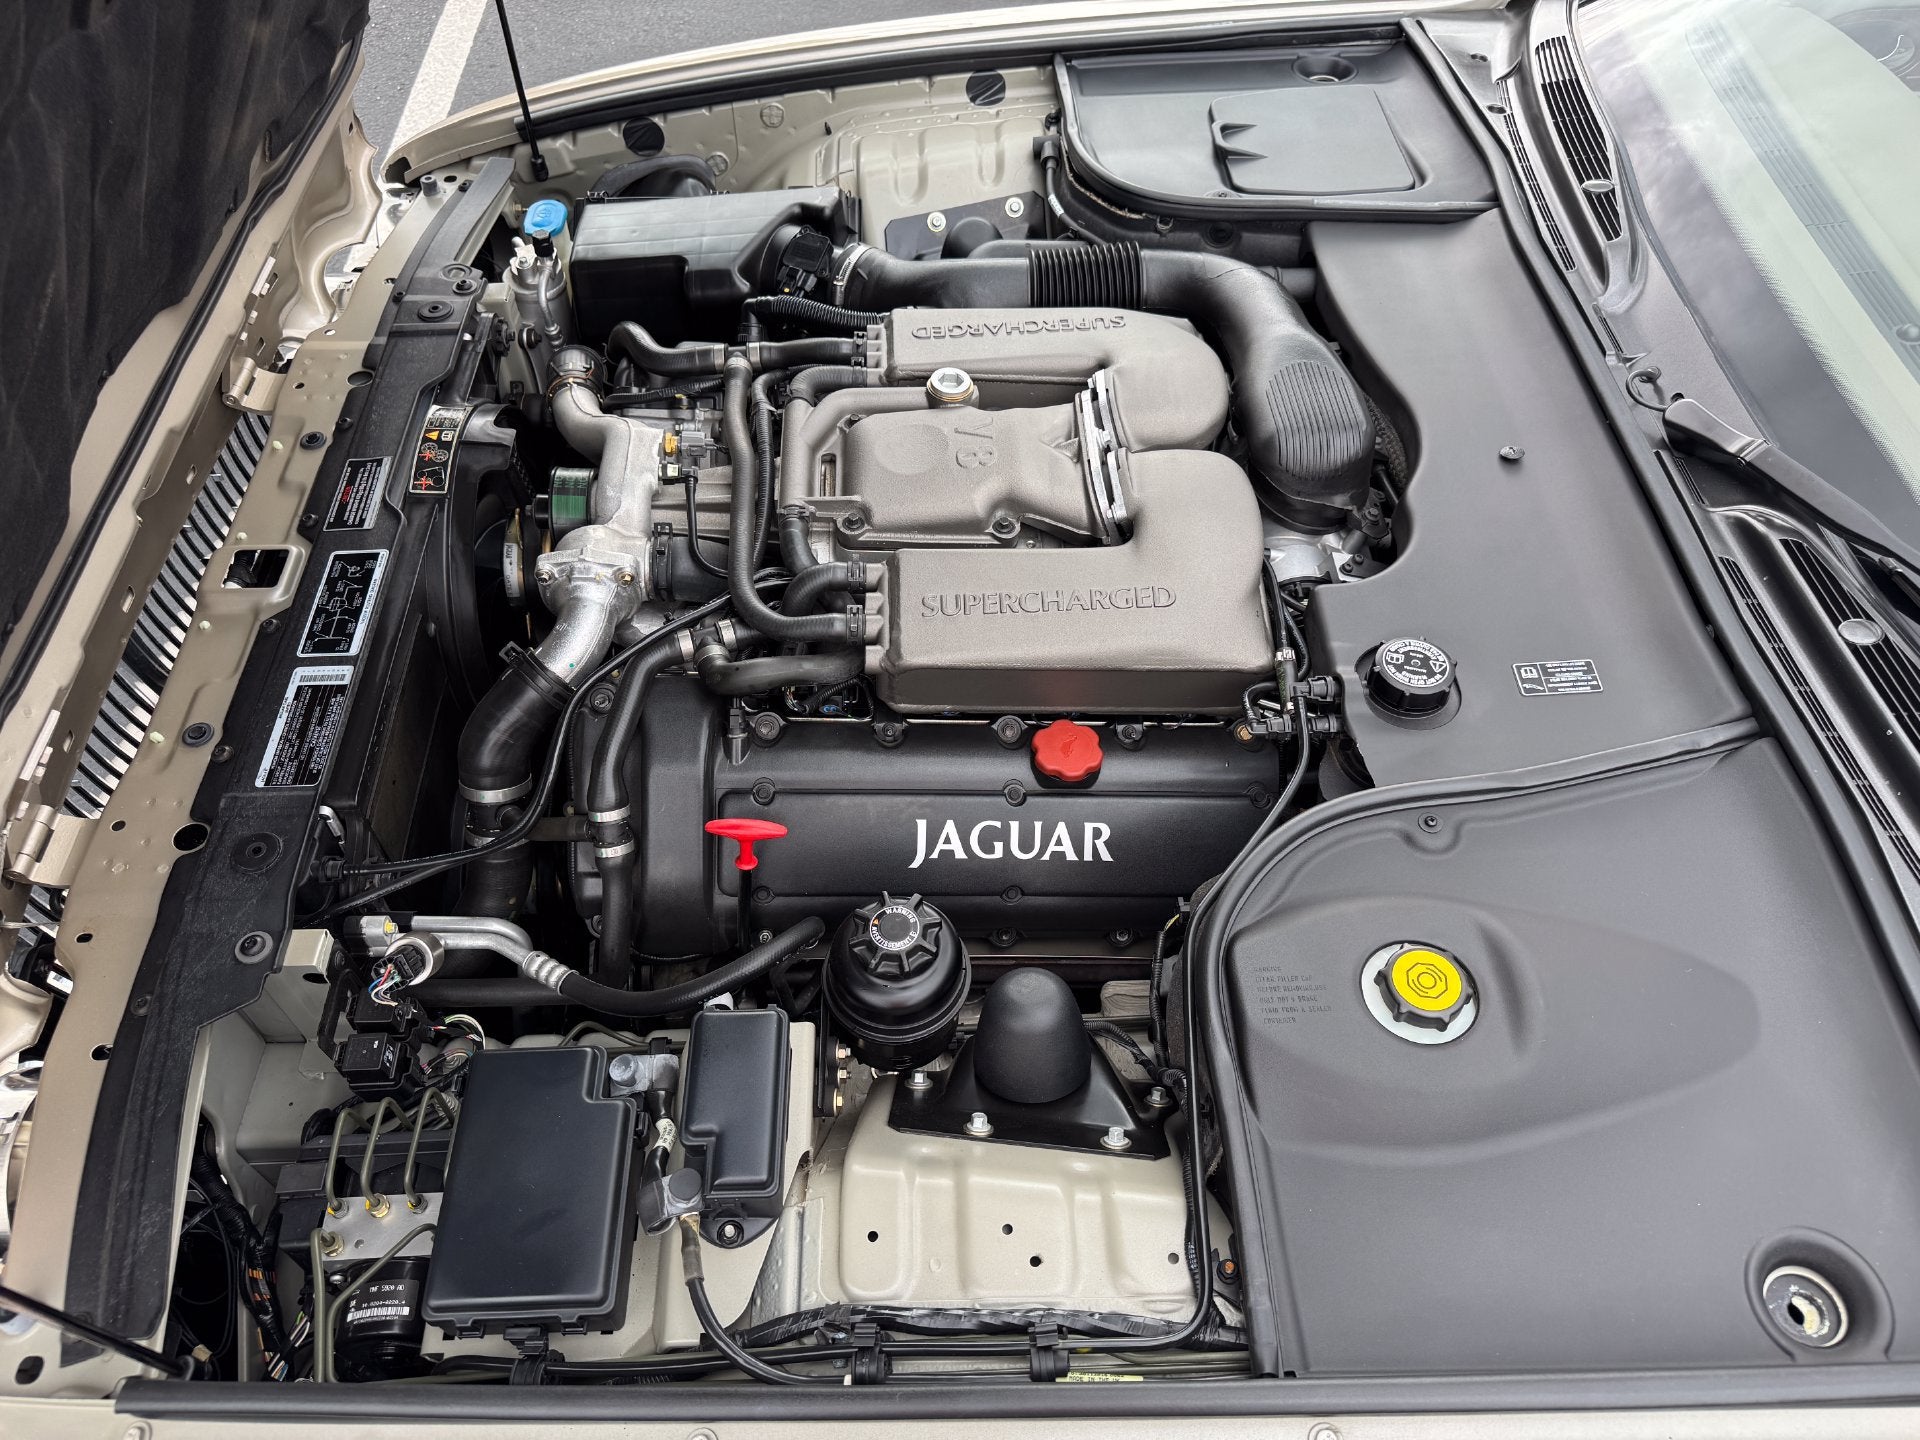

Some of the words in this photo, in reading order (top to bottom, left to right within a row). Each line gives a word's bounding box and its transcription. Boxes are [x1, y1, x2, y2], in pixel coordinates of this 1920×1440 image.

[911, 315, 1127, 340] SUPERCHARGED
[953, 413, 997, 470] V8
[921, 584, 1177, 618] SUPERCHARGED
[908, 818, 1114, 869] JAGUAR
[885, 908, 916, 923] WARNING
[872, 926, 912, 948] AVERTISSEMENT
